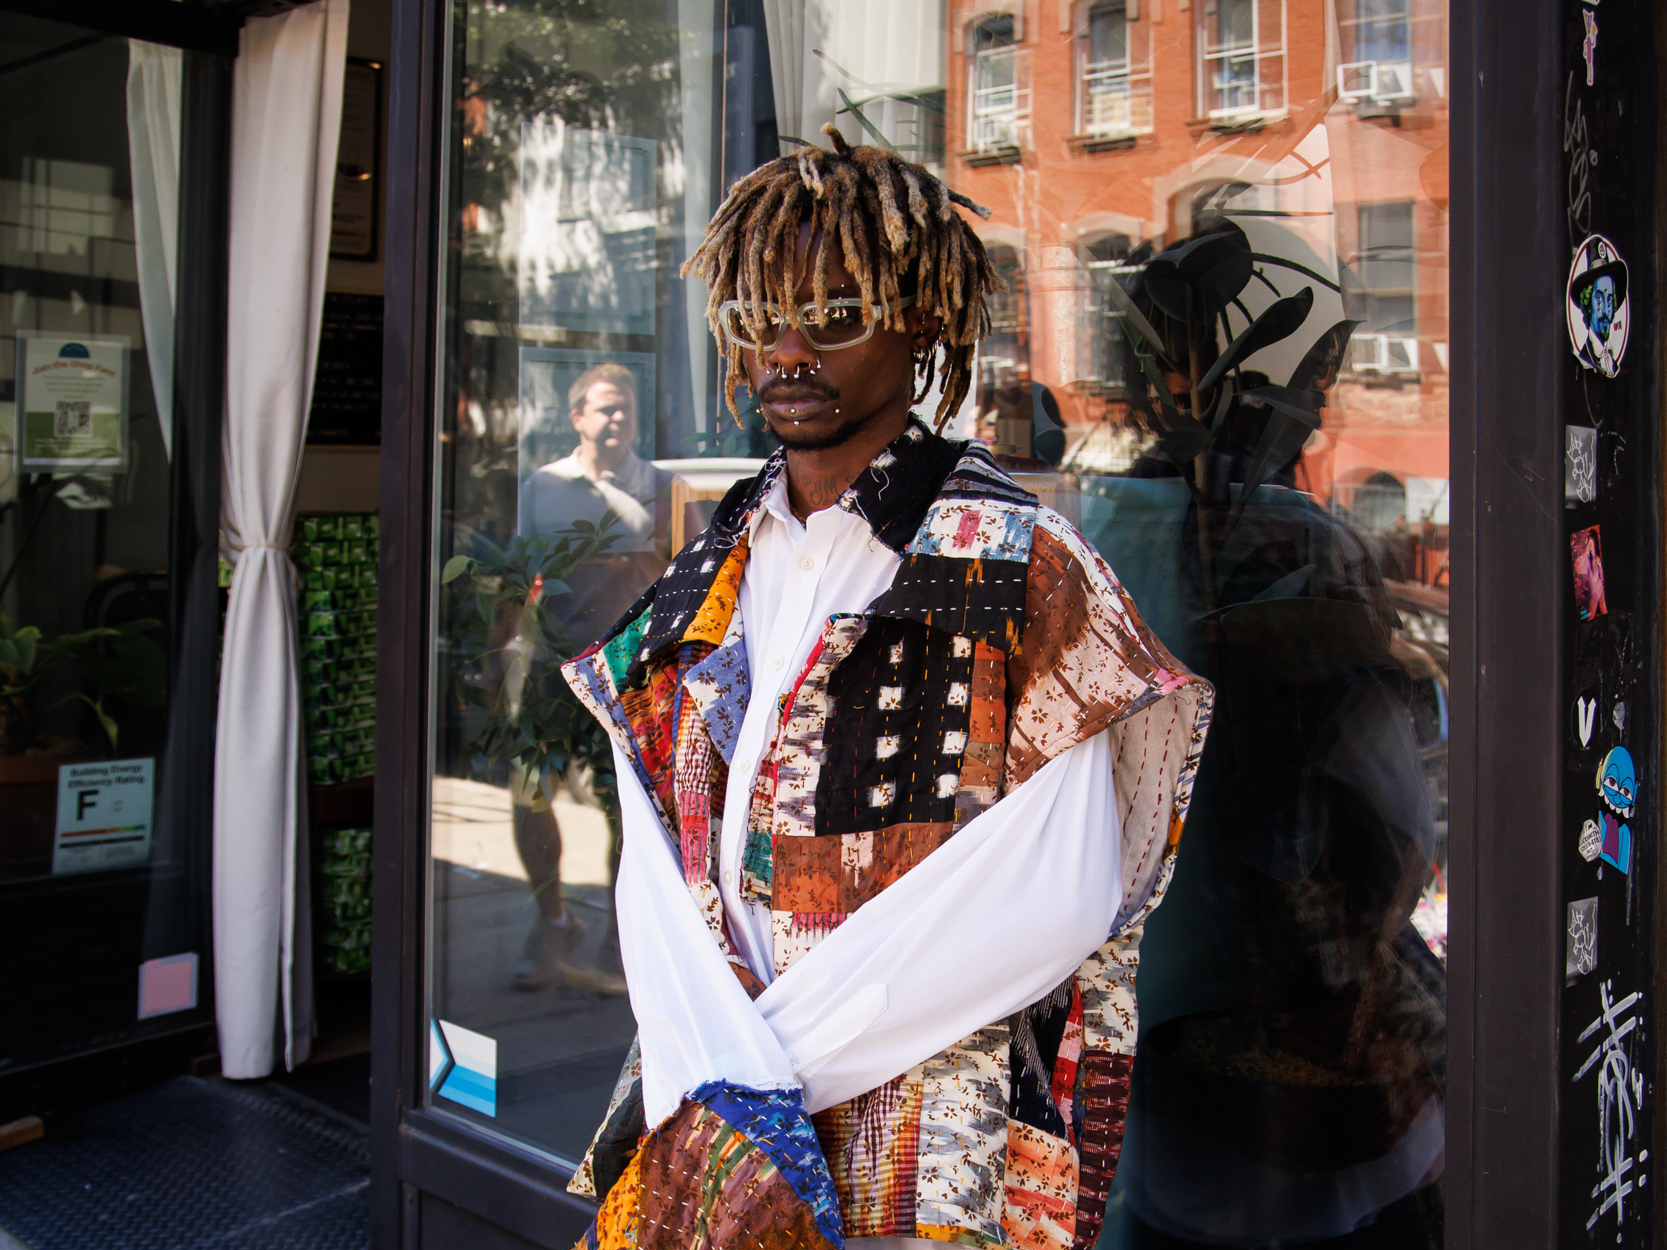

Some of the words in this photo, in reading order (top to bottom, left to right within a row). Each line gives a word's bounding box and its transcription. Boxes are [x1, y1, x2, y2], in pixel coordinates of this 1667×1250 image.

[32, 364, 51, 375] Join
[52, 360, 68, 369] the
[71, 766, 108, 776] Building
[111, 765, 142, 774] Energy
[68, 778, 112, 789] Efficiency
[115, 775, 145, 785] Rating
[77, 790, 99, 821] F
